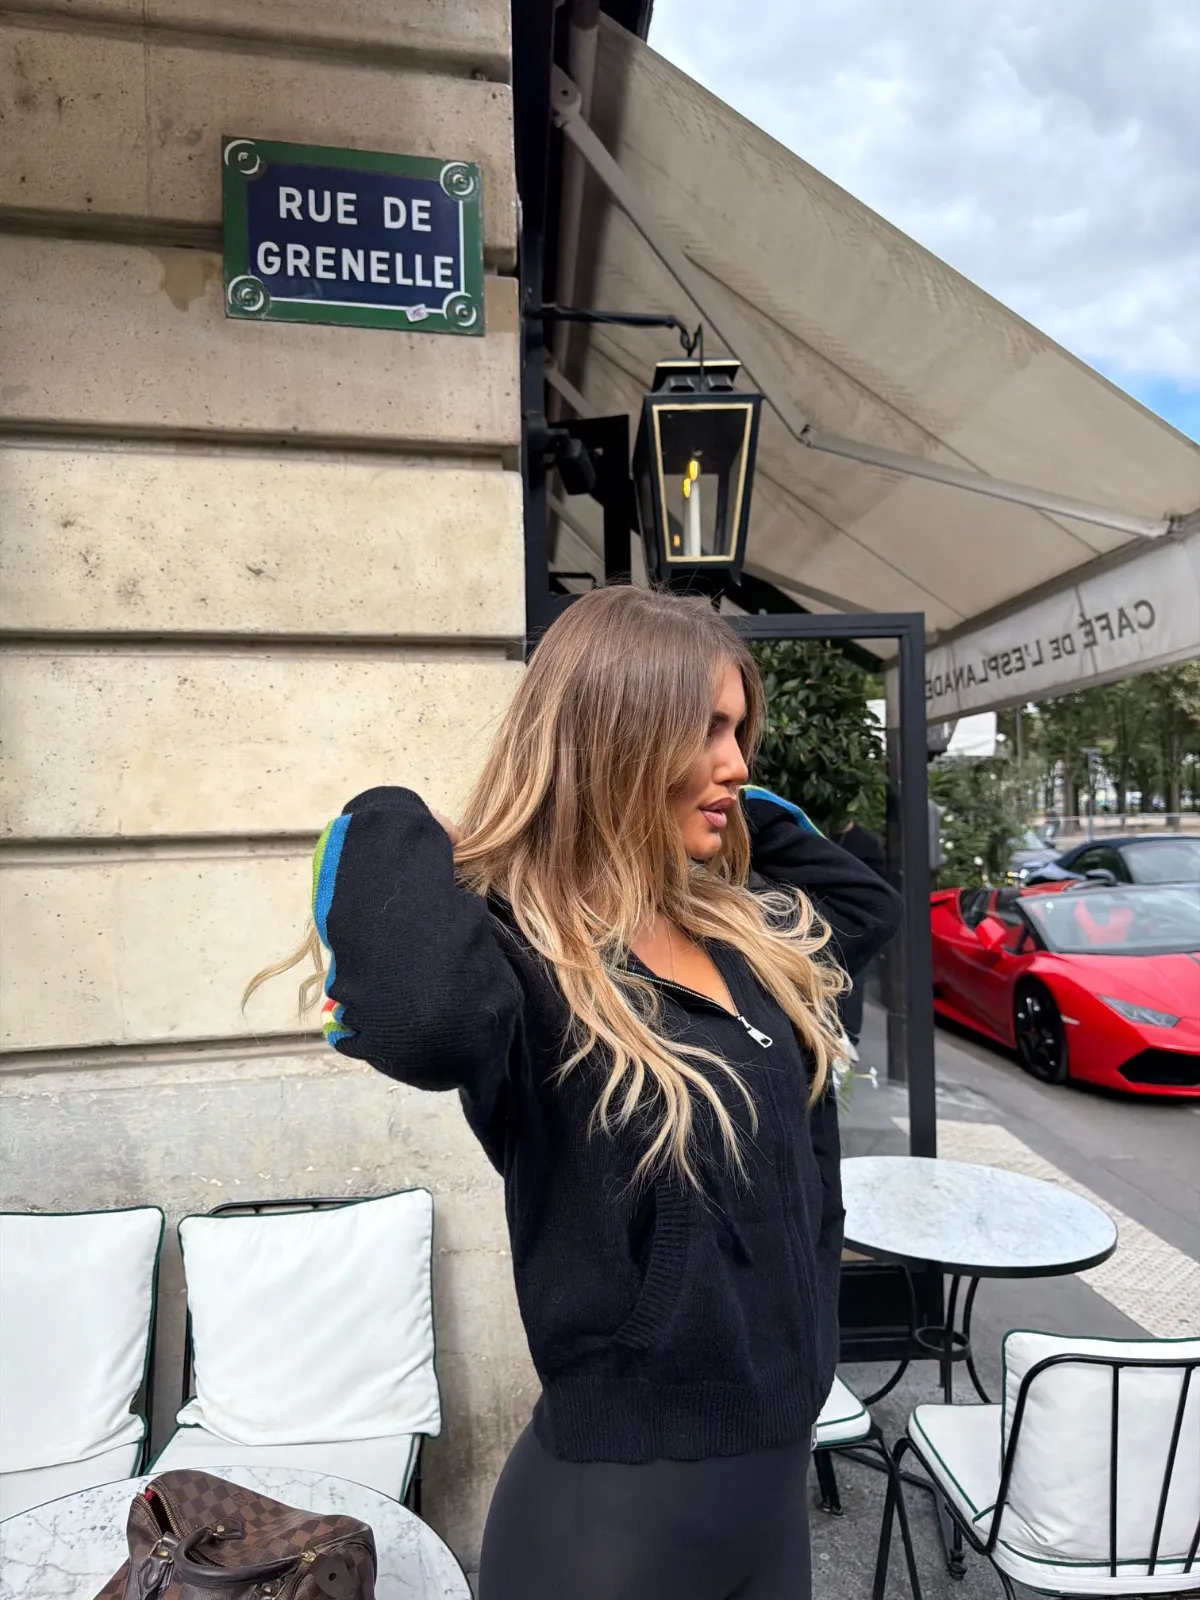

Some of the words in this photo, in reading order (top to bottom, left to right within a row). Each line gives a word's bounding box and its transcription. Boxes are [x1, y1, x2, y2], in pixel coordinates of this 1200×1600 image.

[278, 186, 358, 225] RUE
[383, 196, 432, 232] DE
[256, 241, 454, 289] GRENELLE
